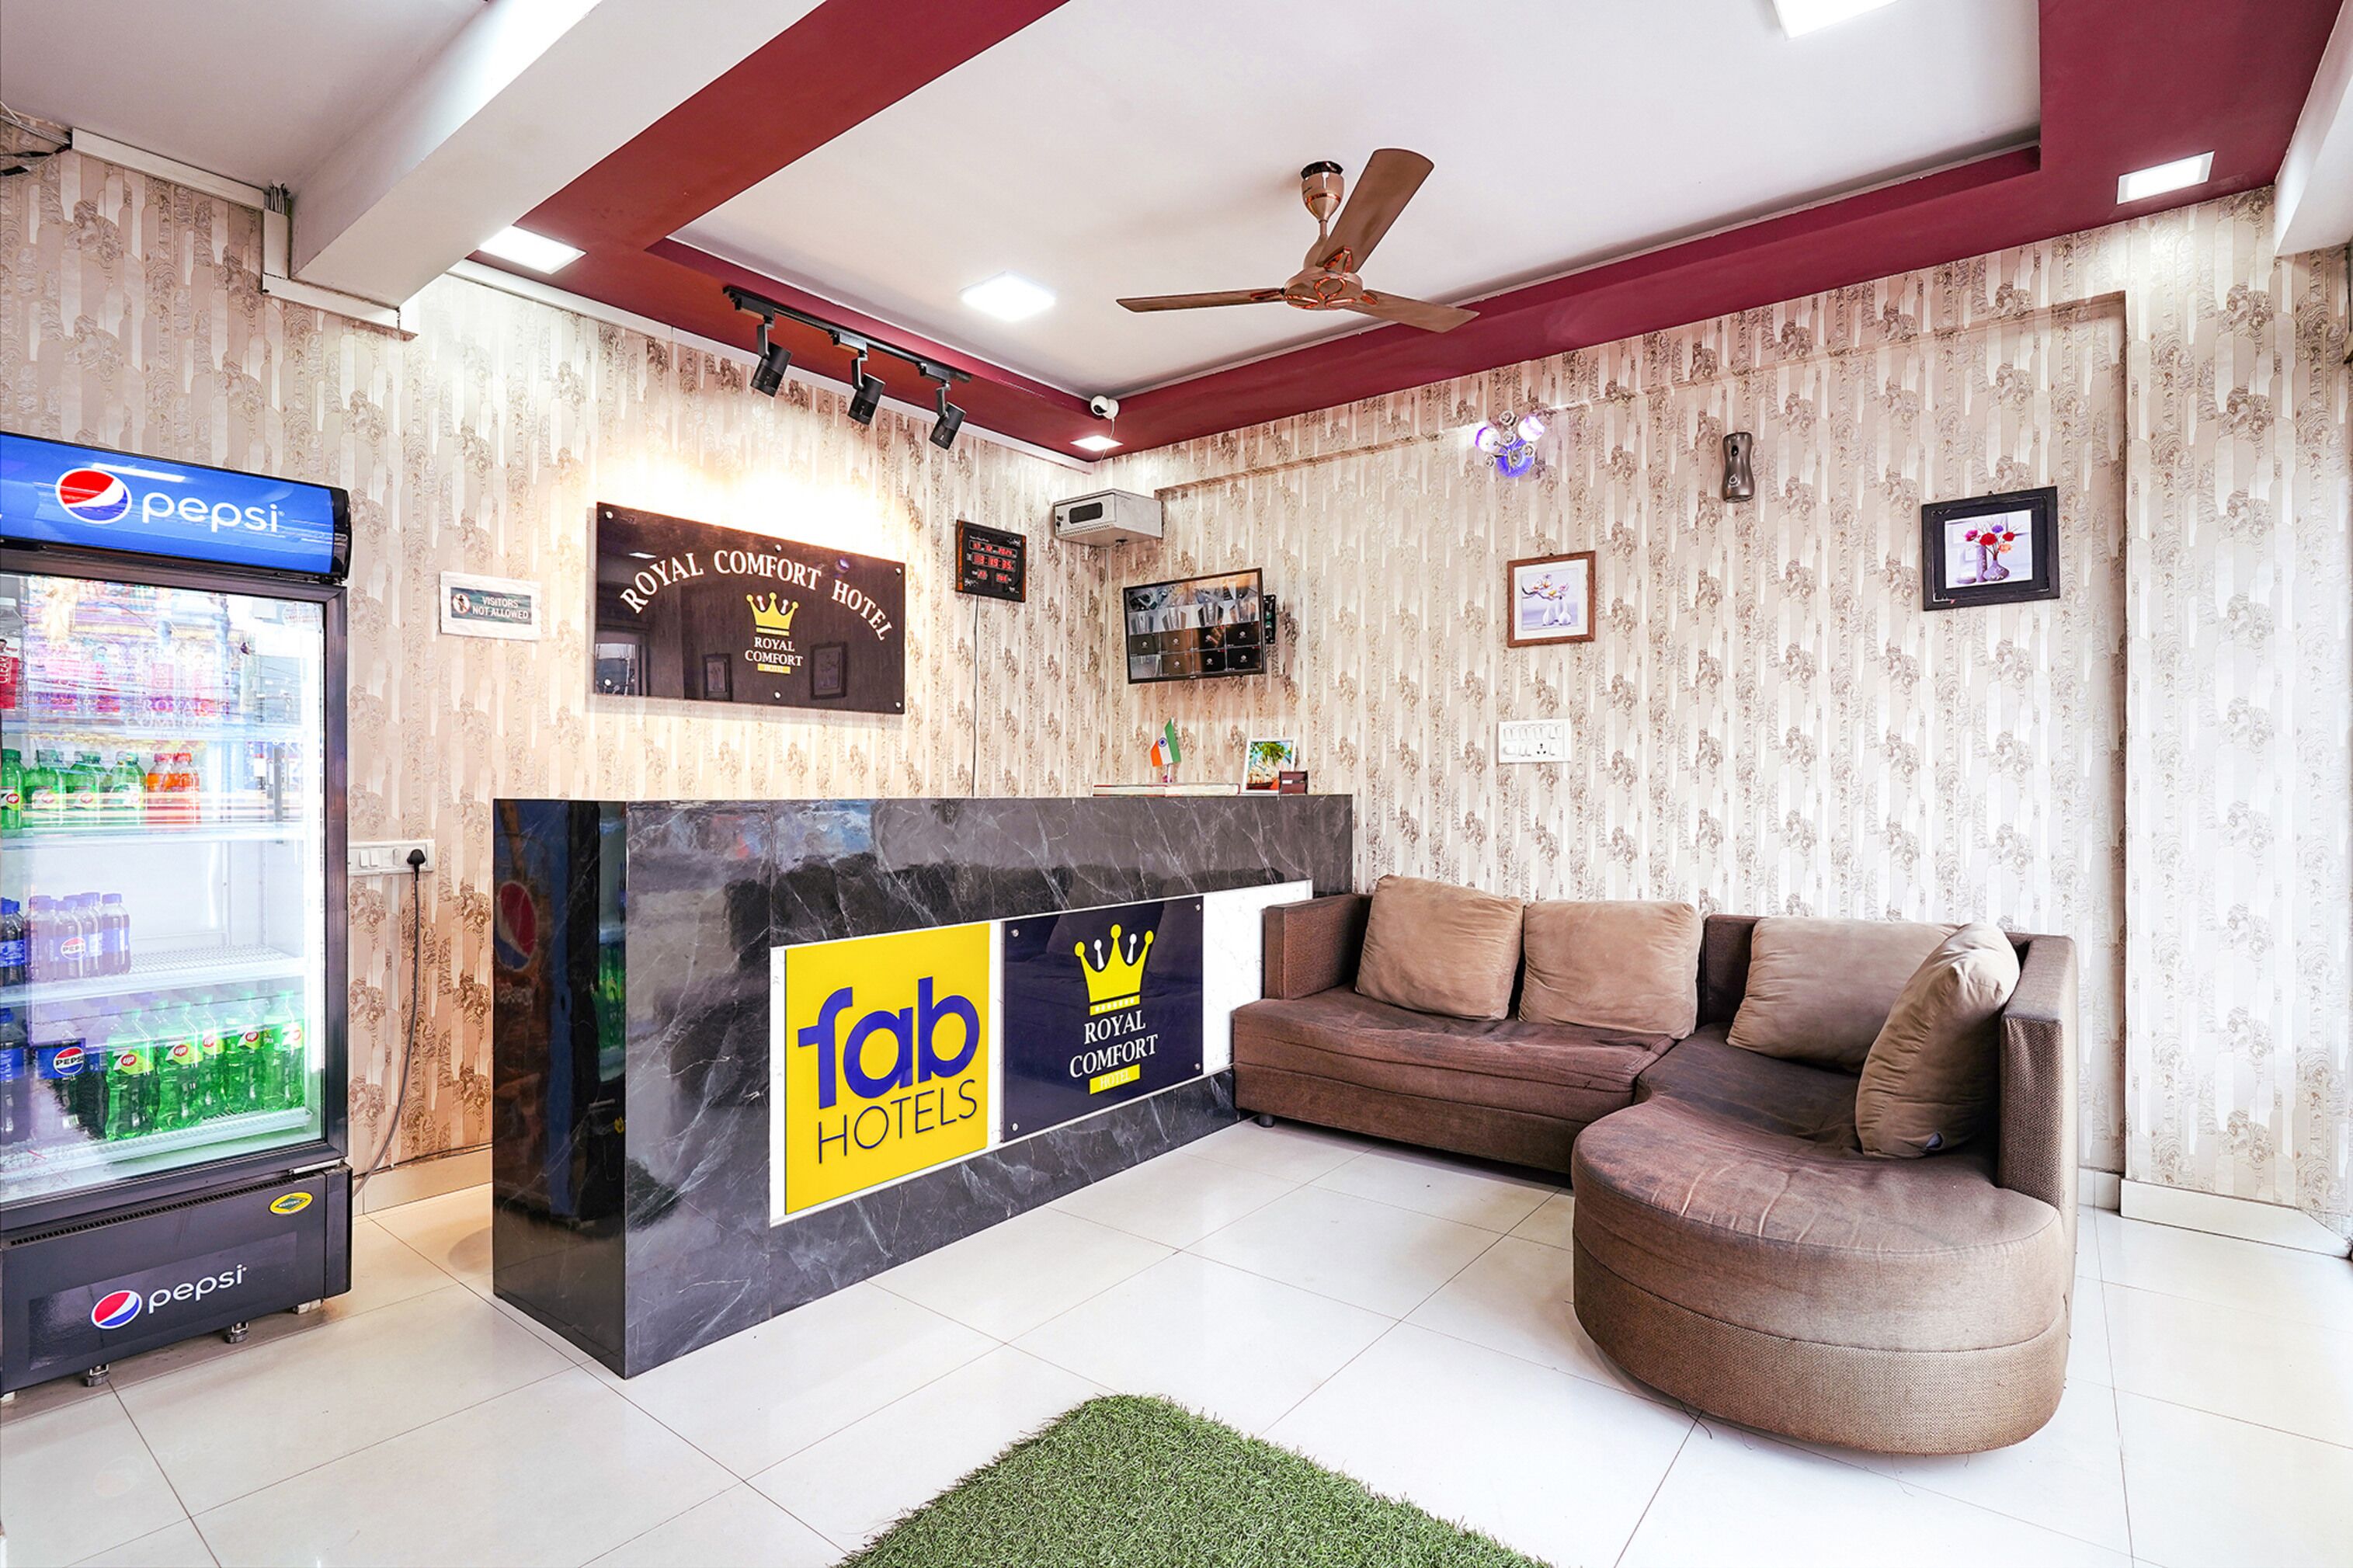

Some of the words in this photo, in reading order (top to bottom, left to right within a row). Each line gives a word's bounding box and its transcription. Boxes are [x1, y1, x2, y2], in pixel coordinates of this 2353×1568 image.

[141, 492, 279, 533] pepsi
[472, 606, 489, 616] NOT
[490, 608, 529, 619] ALLOWED
[481, 596, 519, 608] VISITORS
[620, 552, 704, 614] ROYAL
[713, 550, 822, 591] COMFORT
[831, 579, 894, 641] HOTEL
[745, 650, 804, 666] COMFORT
[754, 637, 795, 652] ROYAL
[798, 976, 980, 1110] fab
[1083, 1010, 1146, 1045] ROYAL
[1069, 1034, 1159, 1079] COMFORT
[1100, 1069, 1131, 1088] HOTEL
[818, 1079, 978, 1164] HOTELS
[148, 1264, 244, 1314] pepsi
